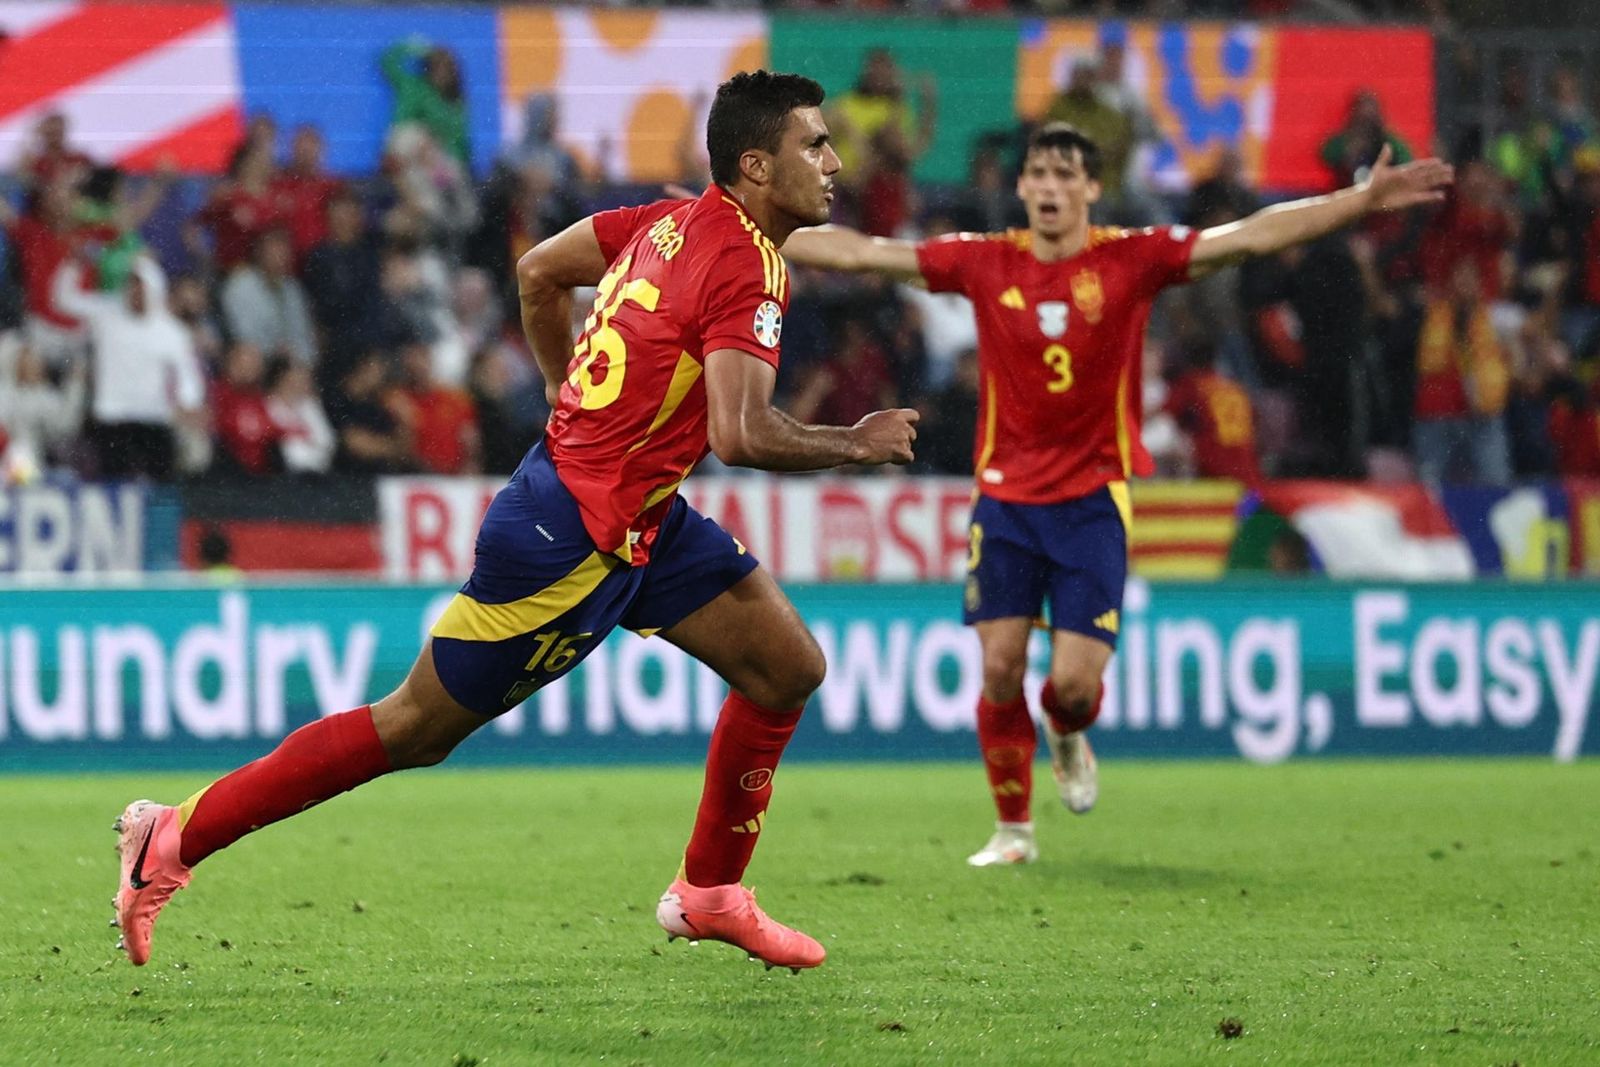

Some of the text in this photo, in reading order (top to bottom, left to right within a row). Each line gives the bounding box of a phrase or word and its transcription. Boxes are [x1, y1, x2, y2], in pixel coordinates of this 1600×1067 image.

[568, 254, 661, 411] 16
[1043, 344, 1074, 393] 3
[0, 586, 379, 742] undry
[1353, 589, 1600, 763] Easy
[525, 630, 592, 672] 16
